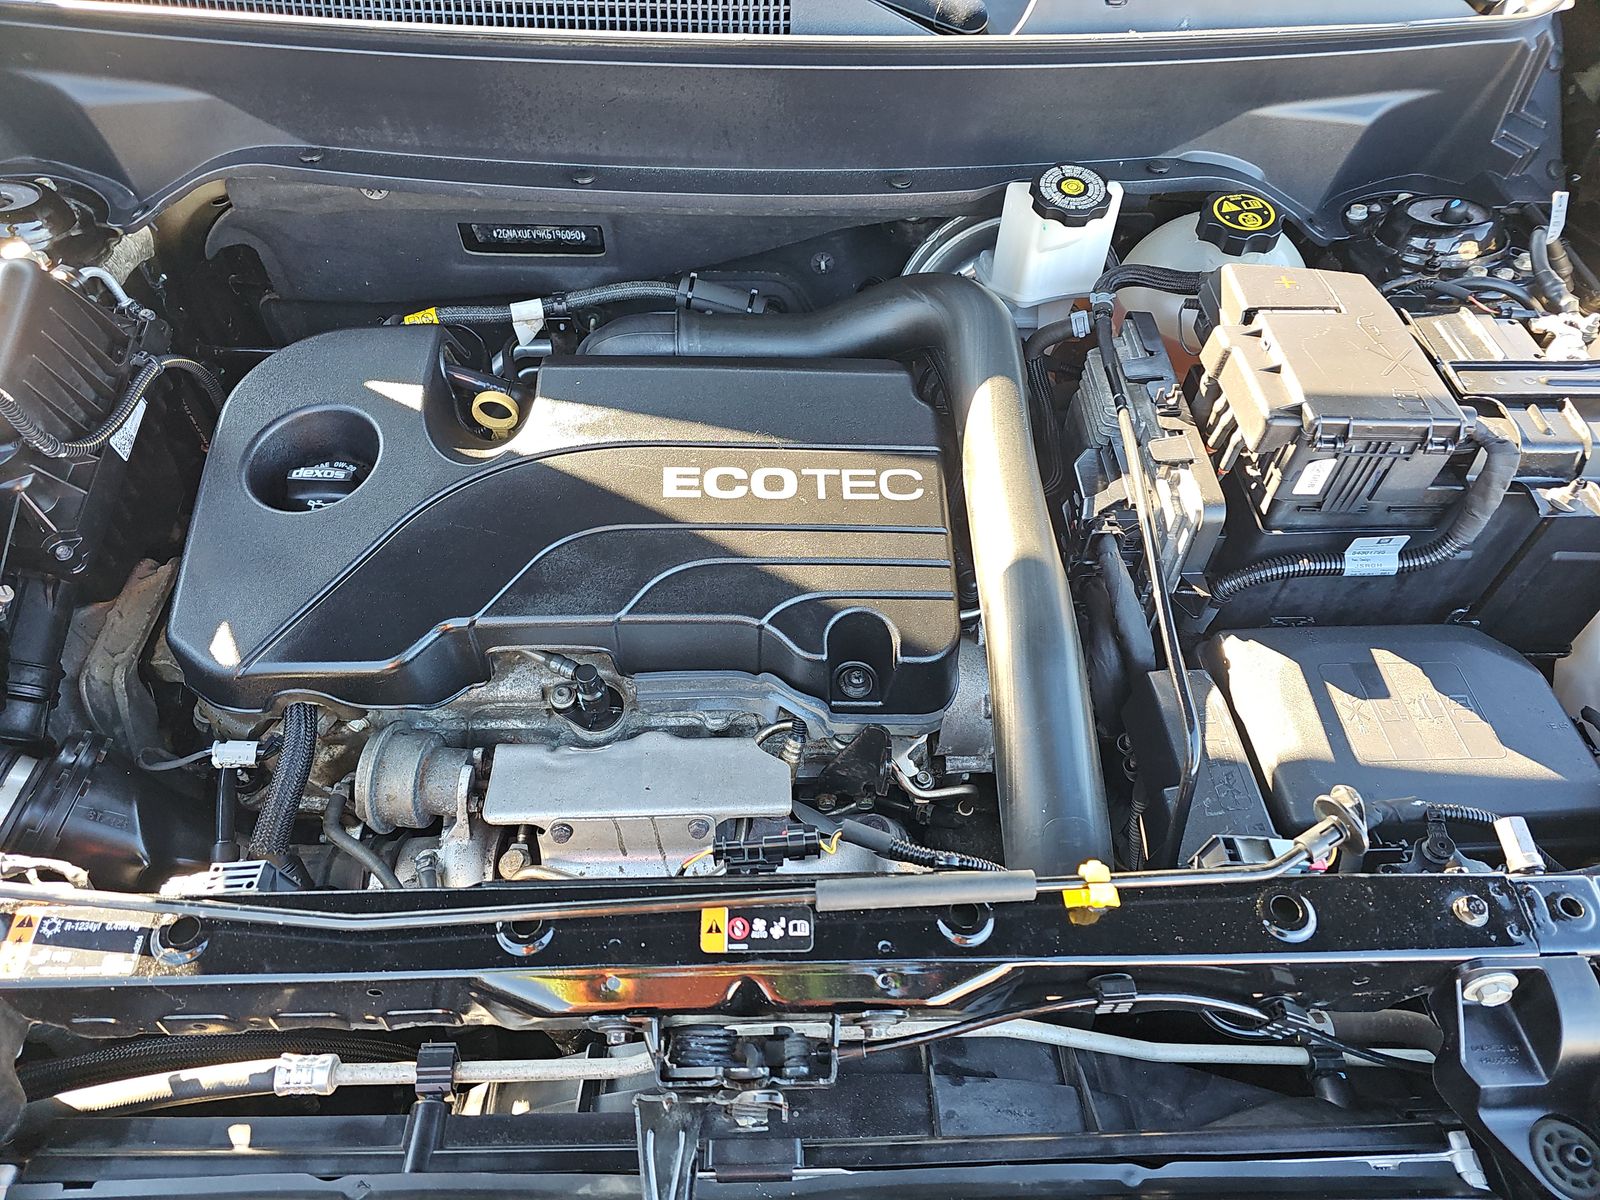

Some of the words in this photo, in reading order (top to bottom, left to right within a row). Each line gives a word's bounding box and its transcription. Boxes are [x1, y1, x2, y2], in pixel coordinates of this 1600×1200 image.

[333, 461, 357, 472] 0W-20
[291, 467, 346, 479] dexos
[662, 466, 925, 501] ECOTEC
